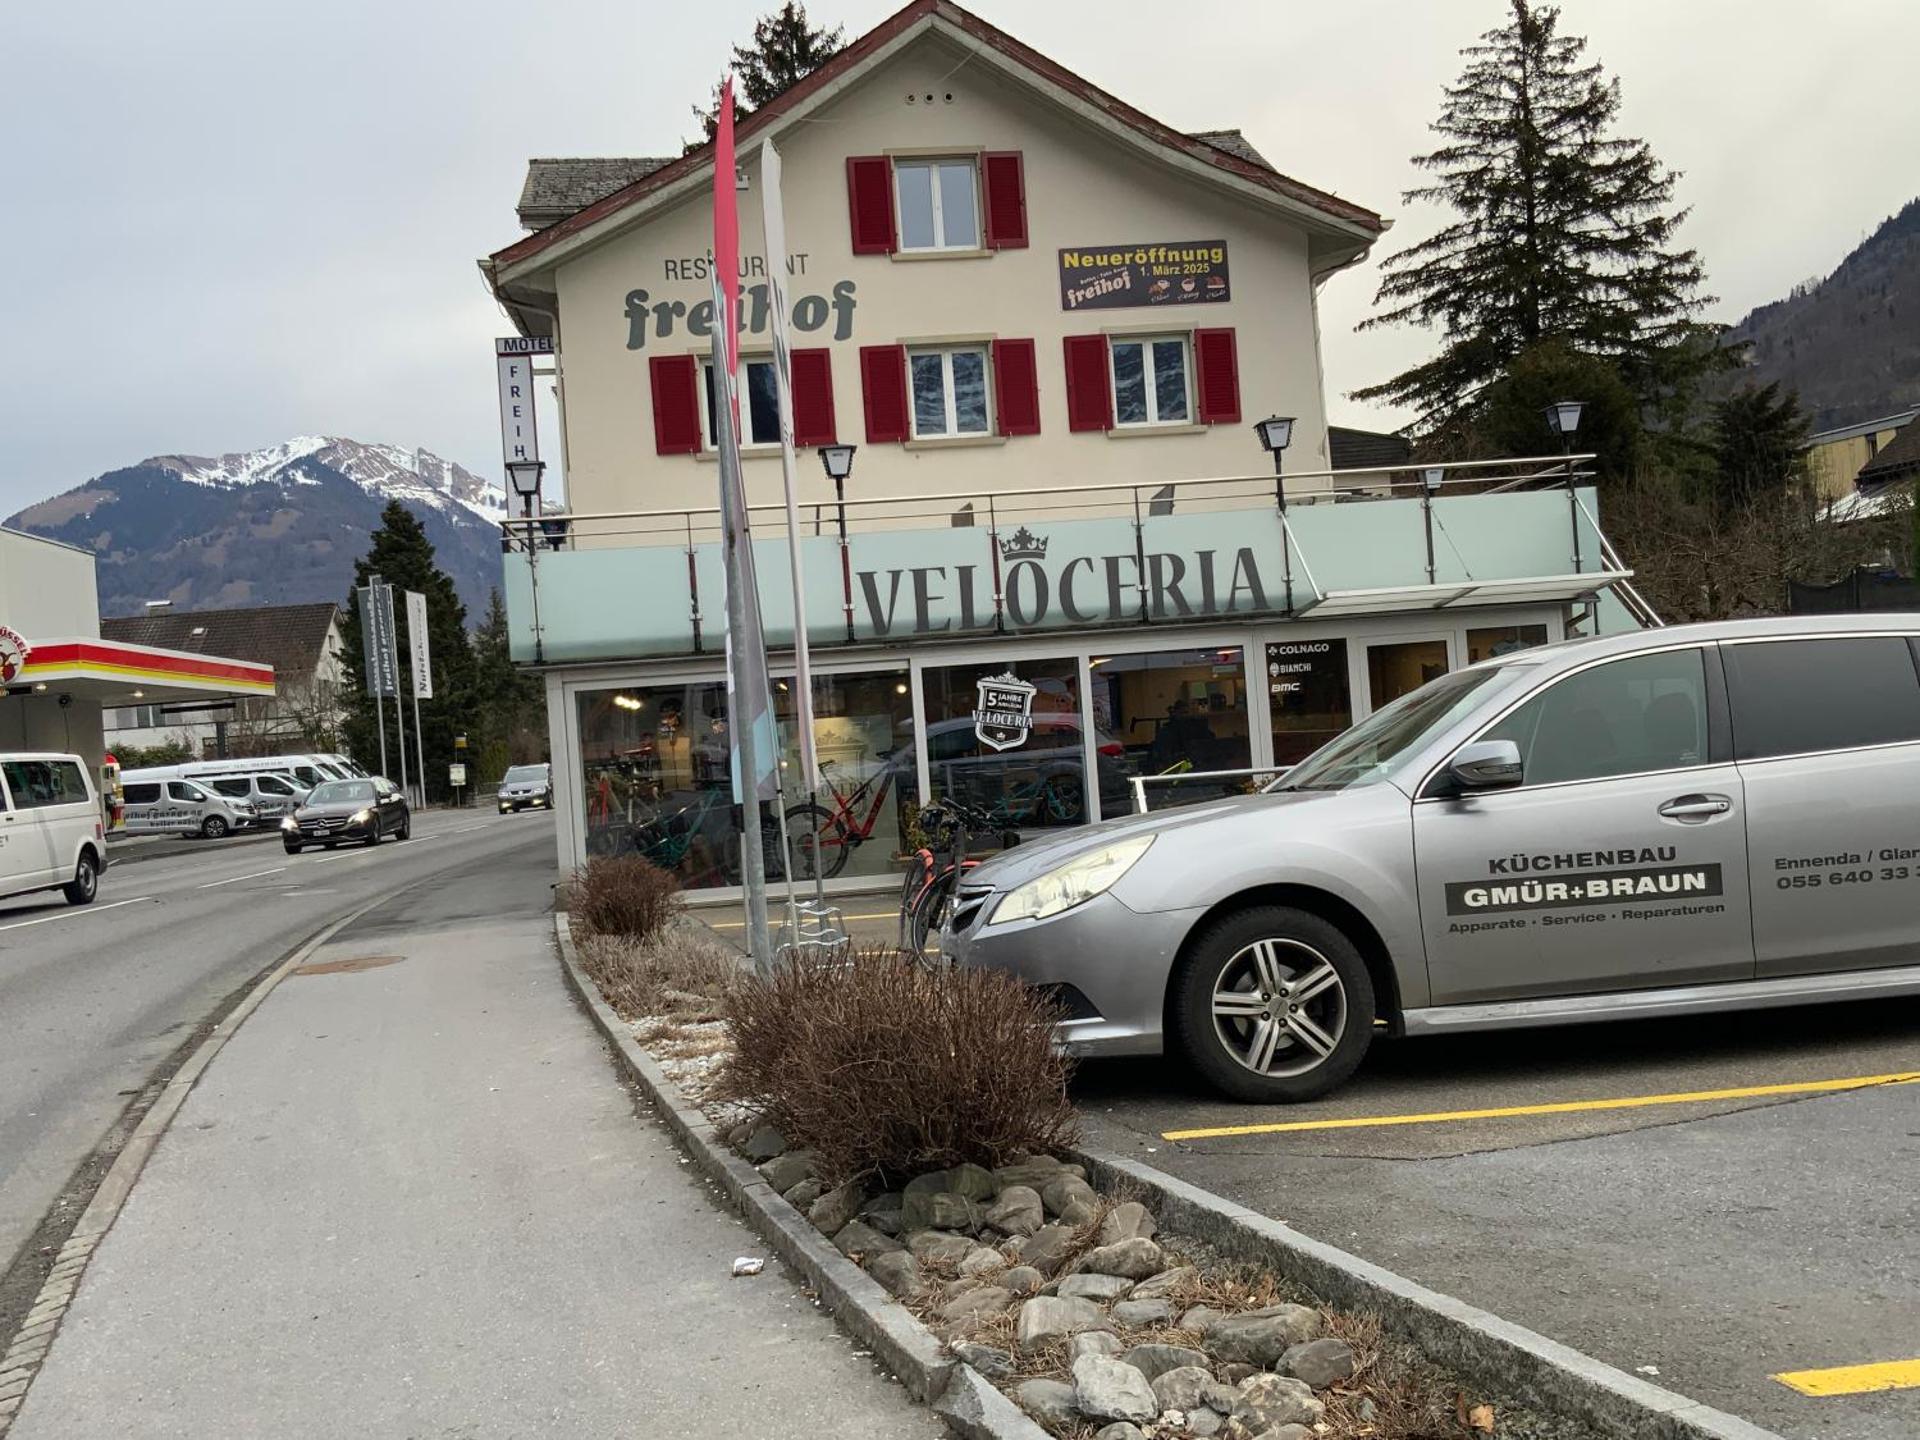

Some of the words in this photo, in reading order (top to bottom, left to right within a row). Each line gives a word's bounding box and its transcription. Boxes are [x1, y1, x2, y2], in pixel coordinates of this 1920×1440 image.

[664, 253, 809, 281] RESURNT
[1063, 247, 1223, 268] Neueröffnung
[1140, 266, 1150, 277] 1.
[1152, 265, 1181, 277] März
[1183, 263, 1210, 275] 2025
[1067, 271, 1132, 308] freihof
[504, 338, 554, 351] MOTEL
[510, 365, 525, 457] FREIH
[856, 547, 1271, 636] VELOCERIA
[1280, 643, 1330, 655] COLNAGO
[1280, 663, 1312, 673] BIANCHI
[987, 692, 997, 706] 5
[998, 693, 1023, 703] JAHRE
[972, 710, 1034, 728] VELOCERIA
[1489, 846, 1677, 874] KÜCHENBAU
[1775, 852, 1861, 870] Ennenda
[1777, 874, 1822, 889] 055
[1829, 870, 1873, 885] 640
[1880, 867, 1909, 880] 33
[1463, 872, 1706, 908] GMÜR+BRAUN
[1449, 916, 1527, 934] Apparate
[1542, 911, 1606, 926] Service
[1622, 902, 1725, 920] Reparaturen
